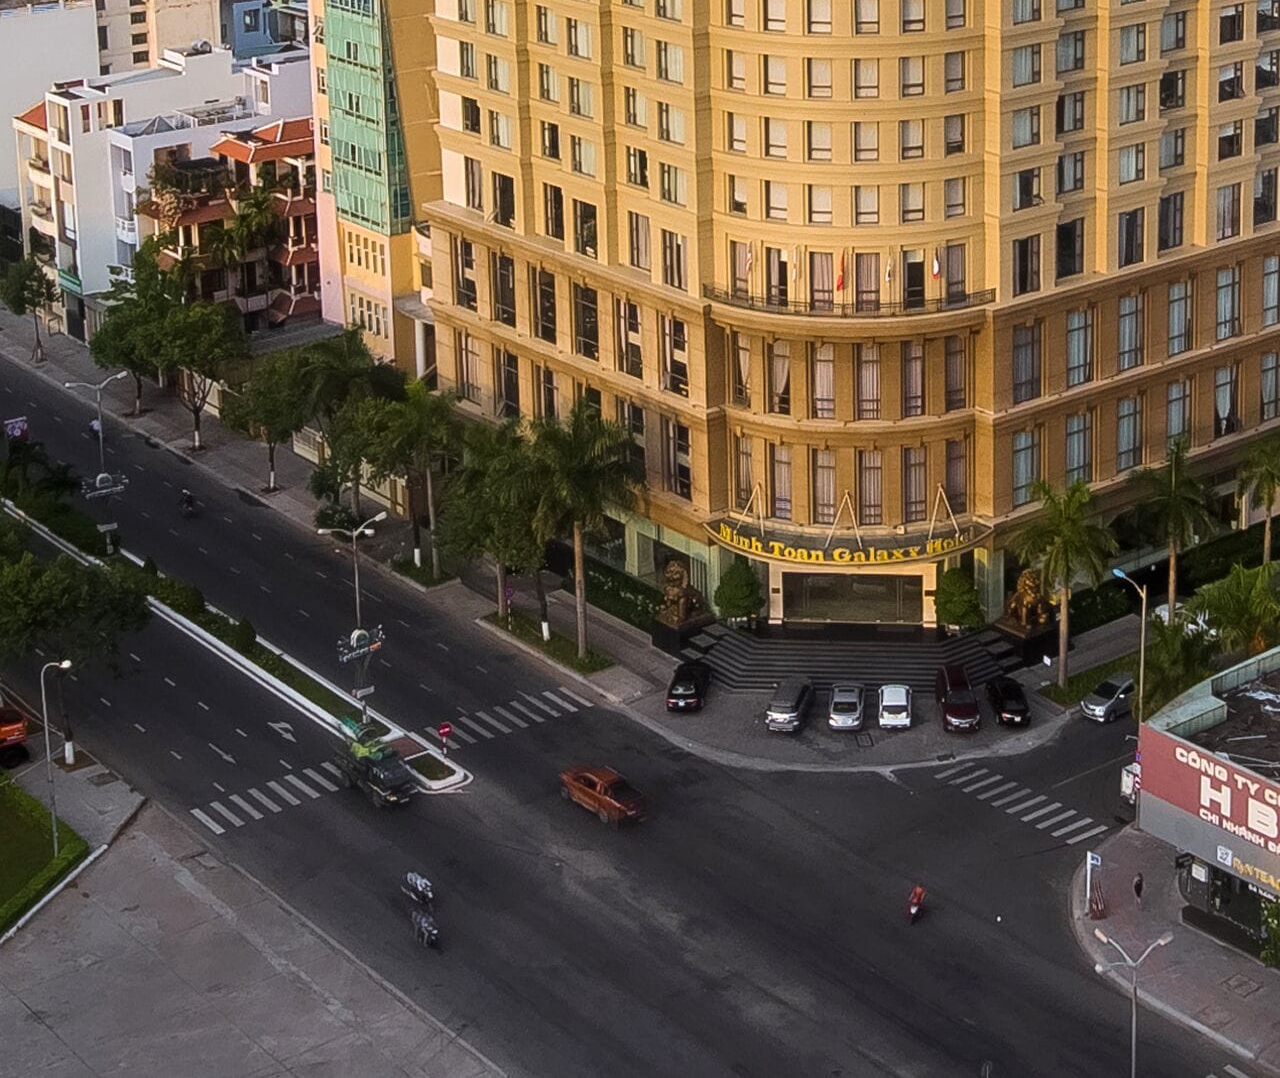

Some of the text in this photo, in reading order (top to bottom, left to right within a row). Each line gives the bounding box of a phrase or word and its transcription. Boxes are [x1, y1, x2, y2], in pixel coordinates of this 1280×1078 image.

[719, 522, 764, 553] Minh
[769, 540, 825, 562] Toan
[832, 544, 922, 562] Galaxy
[1175, 746, 1228, 782] CÔNG
[1233, 773, 1261, 796] TY
[1199, 807, 1220, 826] CHI
